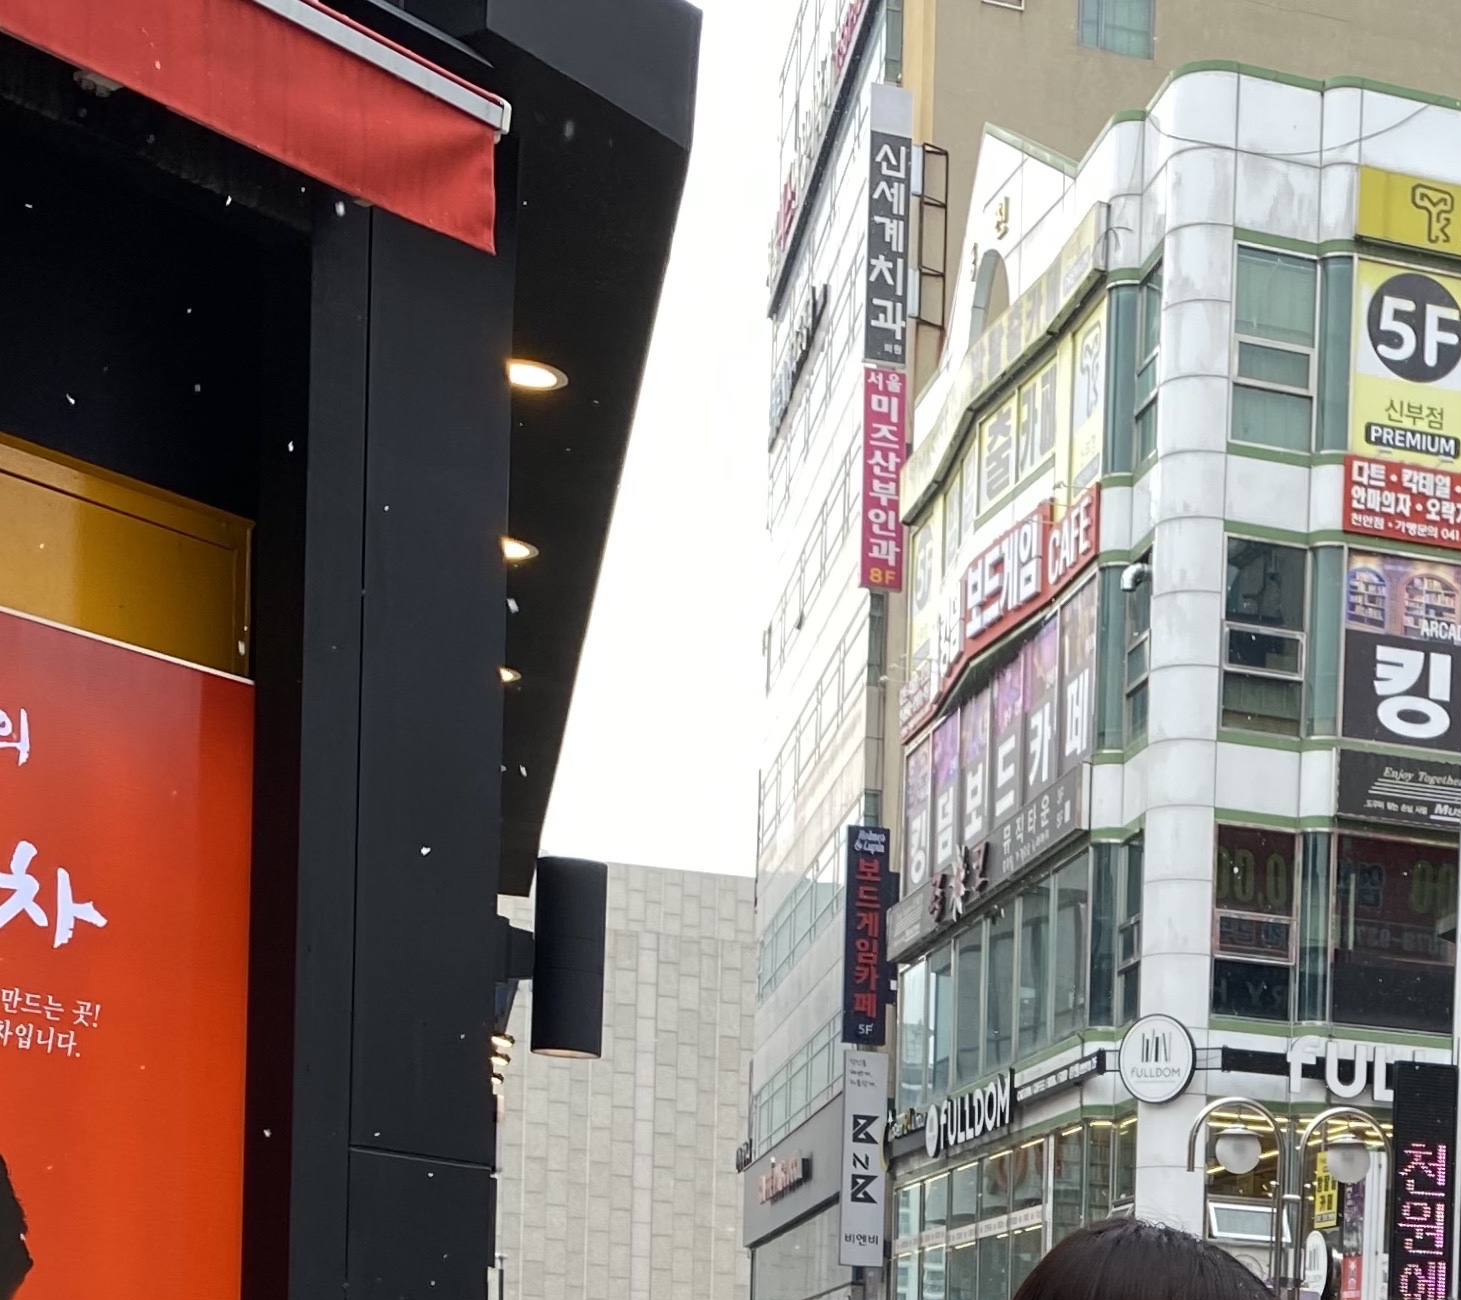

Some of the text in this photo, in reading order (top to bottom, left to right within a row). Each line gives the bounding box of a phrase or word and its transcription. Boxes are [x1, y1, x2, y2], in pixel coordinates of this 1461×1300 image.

[867, 142, 906, 341] 신세계치과
[1375, 295, 1461, 368] 5F
[867, 371, 903, 393] 서울
[1384, 398, 1445, 430] 신부점
[1369, 425, 1456, 458] PREMIUM
[866, 394, 901, 567] 미즈산부인과
[1351, 460, 1452, 500] 다트 칵테일
[1351, 486, 1412, 518] 안마의자
[1350, 512, 1385, 532] 천안점
[868, 566, 896, 585] 8F
[965, 495, 1093, 639] 보드게임 CAFE
[1373, 644, 1452, 740] 킹
[910, 667, 1090, 884] 킹덤보드카페
[1383, 767, 1414, 784] Enjoy
[853, 857, 883, 1020] 보드게임카페
[1, 986, 102, 1030] 만드는 곳!
[856, 1021, 874, 1037] 5F
[844, 1230, 880, 1250] 비엔비
